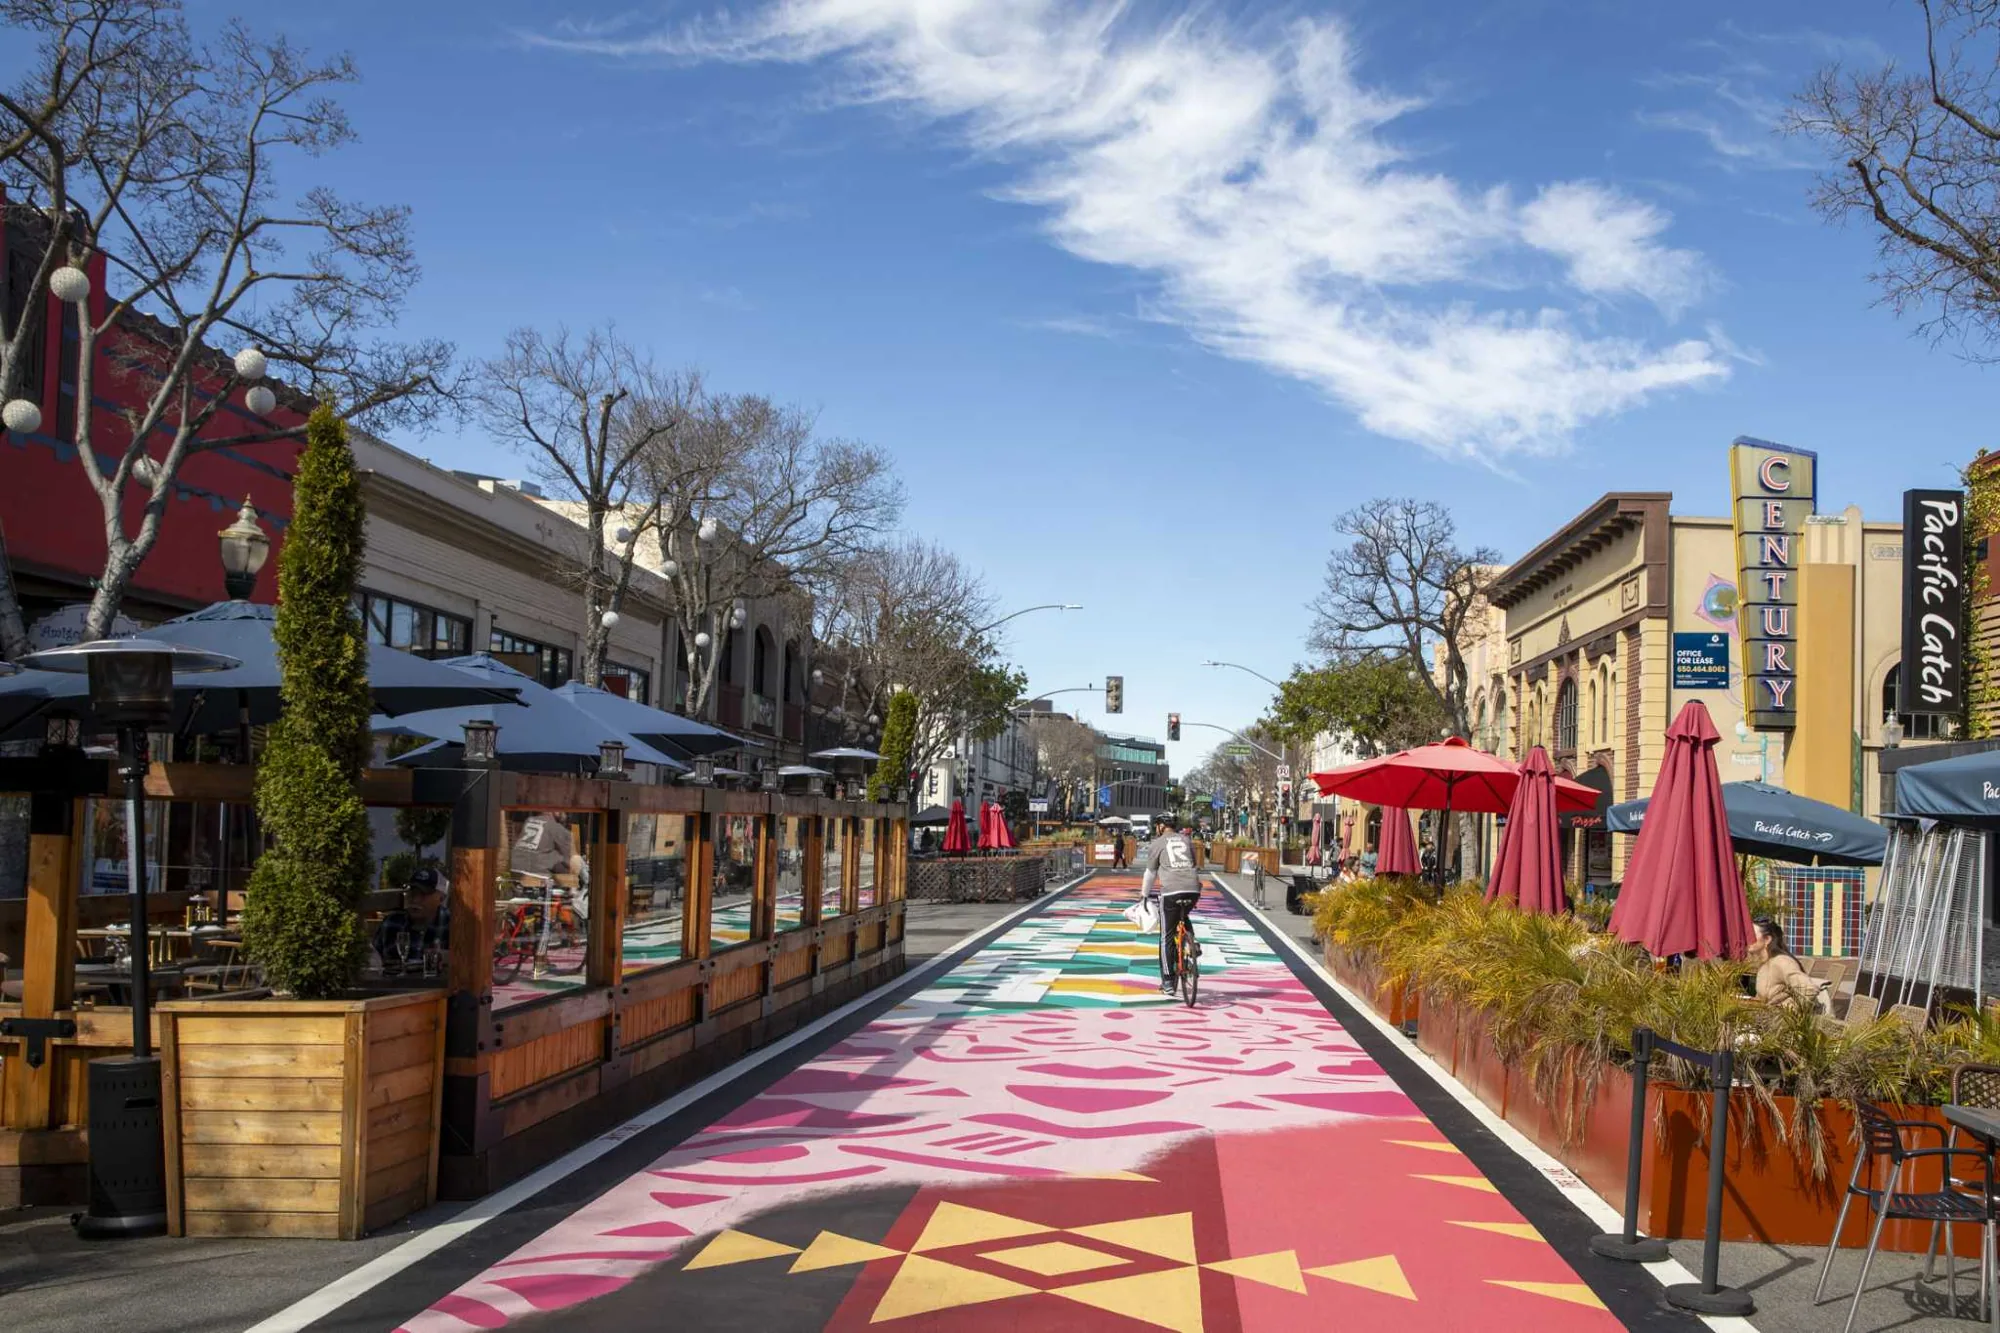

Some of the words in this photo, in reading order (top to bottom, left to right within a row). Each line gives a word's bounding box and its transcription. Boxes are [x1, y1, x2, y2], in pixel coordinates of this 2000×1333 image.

[1760, 455, 1792, 708] CENTURY
[1917, 499, 1958, 605] Pacific
[1920, 612, 1956, 704] Catch
[1754, 820, 1784, 836] Pacific
[1785, 826, 1811, 840] Catch
